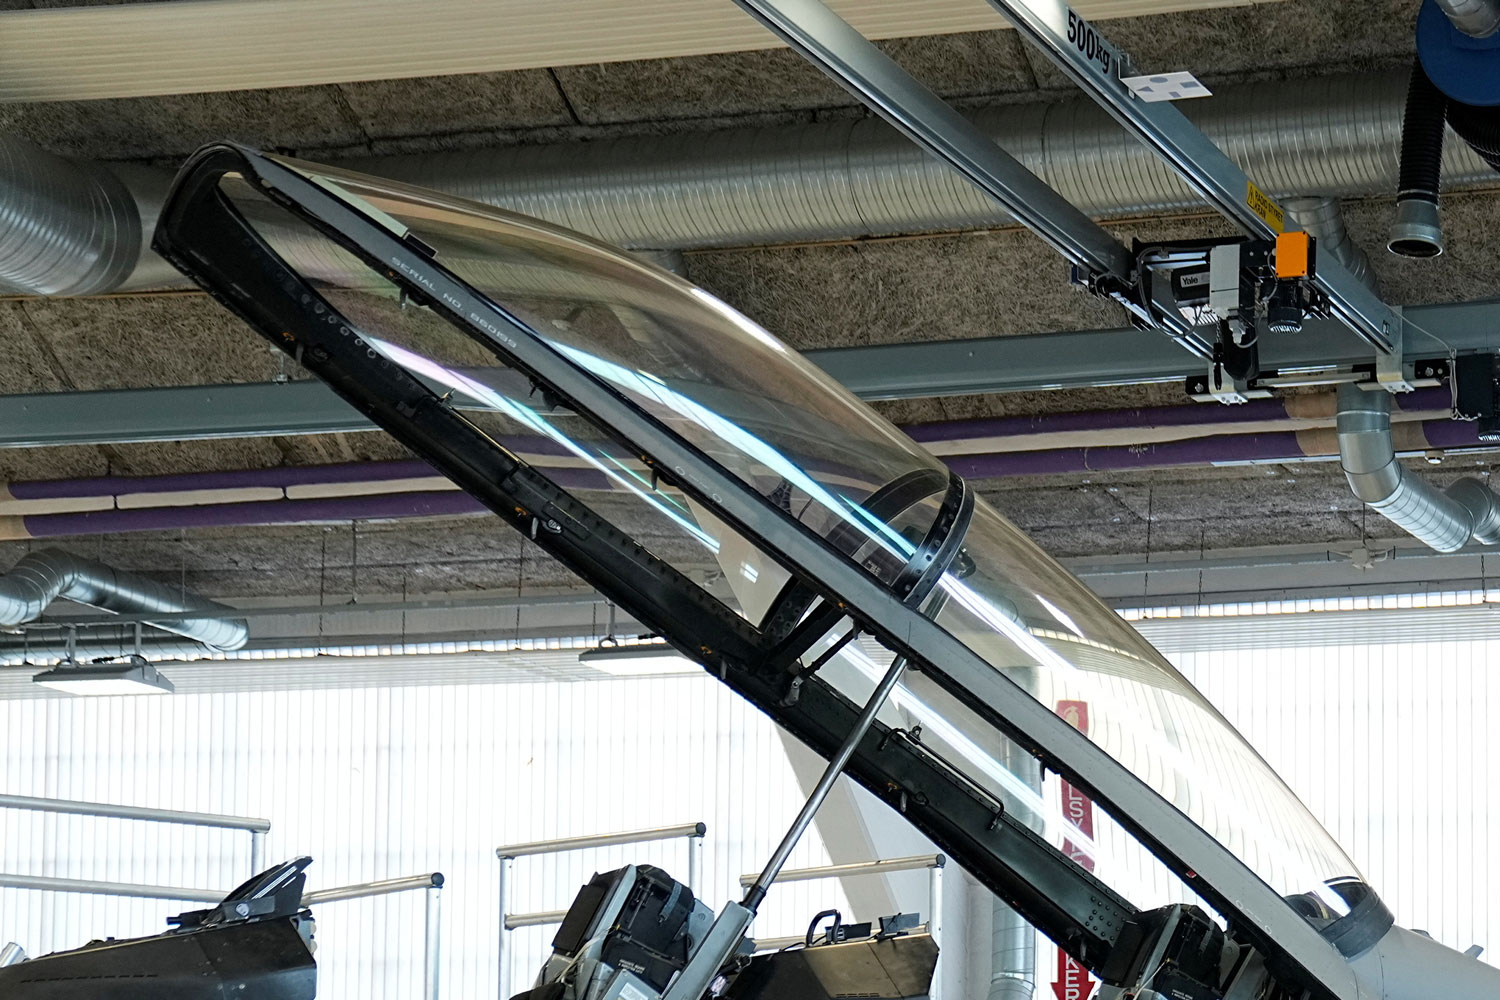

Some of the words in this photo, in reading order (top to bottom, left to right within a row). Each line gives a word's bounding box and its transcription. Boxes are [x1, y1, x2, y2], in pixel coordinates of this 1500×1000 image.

[1067, 9, 1110, 74] 500kg
[391, 256, 436, 291] SERIAL
[1182, 276, 1198, 286] Yale
